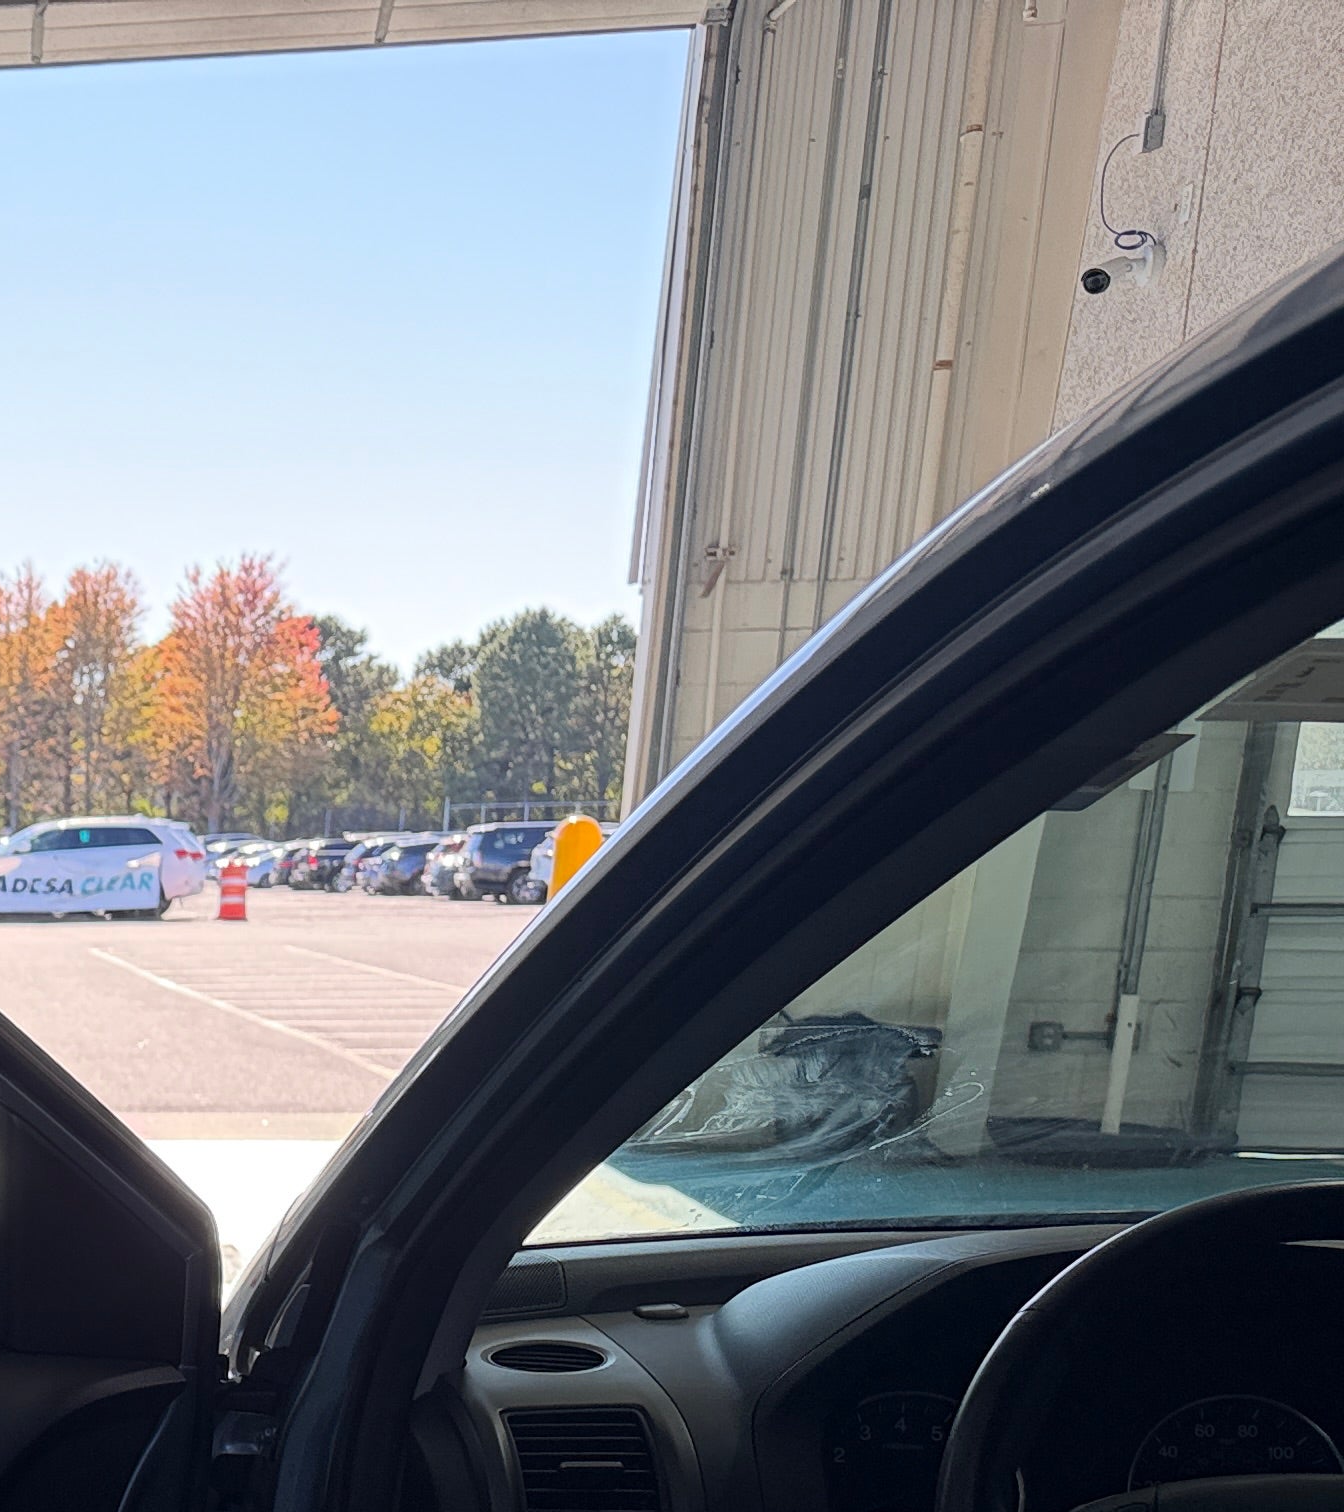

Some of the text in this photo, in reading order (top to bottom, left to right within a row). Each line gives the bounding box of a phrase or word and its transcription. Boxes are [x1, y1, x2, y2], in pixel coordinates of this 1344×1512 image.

[80, 871, 154, 896] CLEAR
[858, 1424, 872, 1441] 3
[894, 1416, 907, 1433] 4
[1194, 1423, 1216, 1439] 60
[1237, 1424, 1259, 1439] 80
[930, 1425, 944, 1442] 5
[832, 1446, 846, 1464] 2
[1158, 1444, 1179, 1459] 40
[1268, 1446, 1295, 1461] 100
